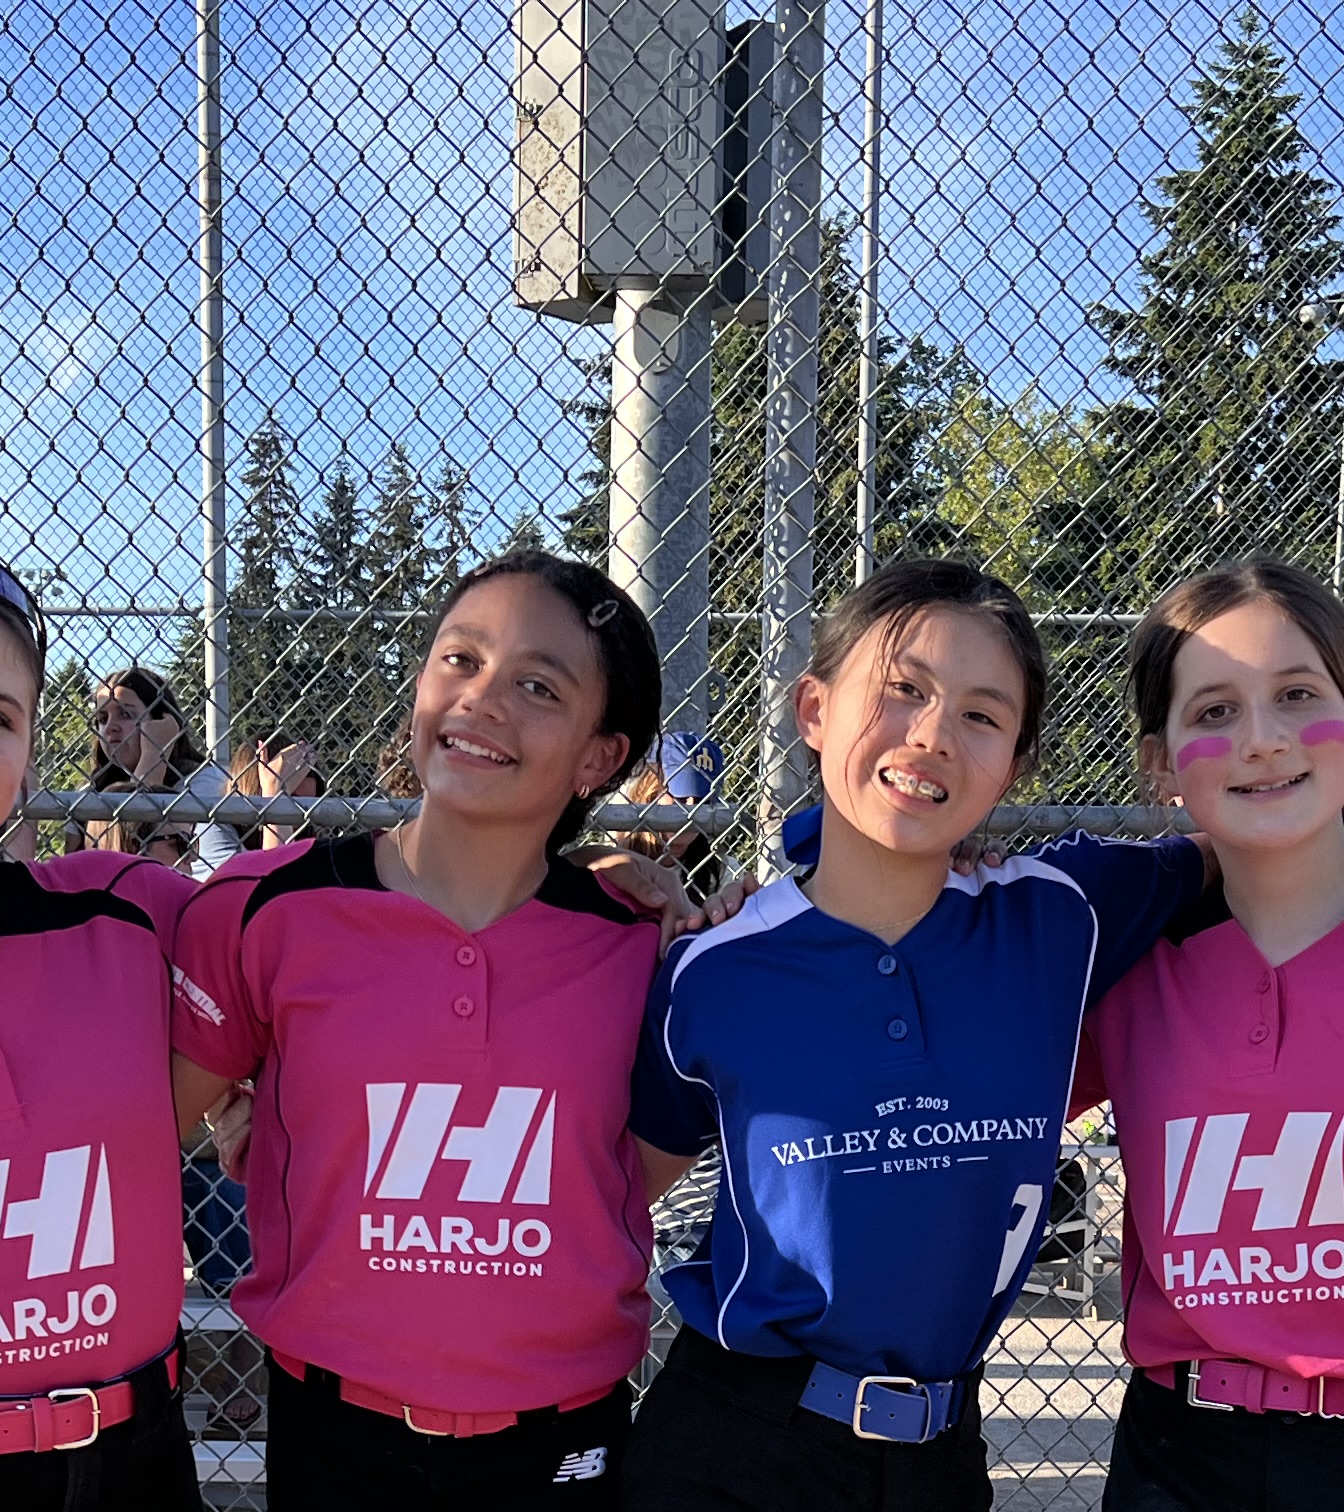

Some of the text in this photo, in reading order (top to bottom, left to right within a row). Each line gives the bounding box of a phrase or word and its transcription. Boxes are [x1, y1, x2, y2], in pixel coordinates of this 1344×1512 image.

[874, 1096, 950, 1118] EST. 2003
[771, 1117, 1049, 1168] VALLEY & COMPANY
[882, 1155, 952, 1174] EVENTS
[359, 1213, 552, 1257] HARJO
[368, 1256, 544, 1277] CONSTRUCTION
